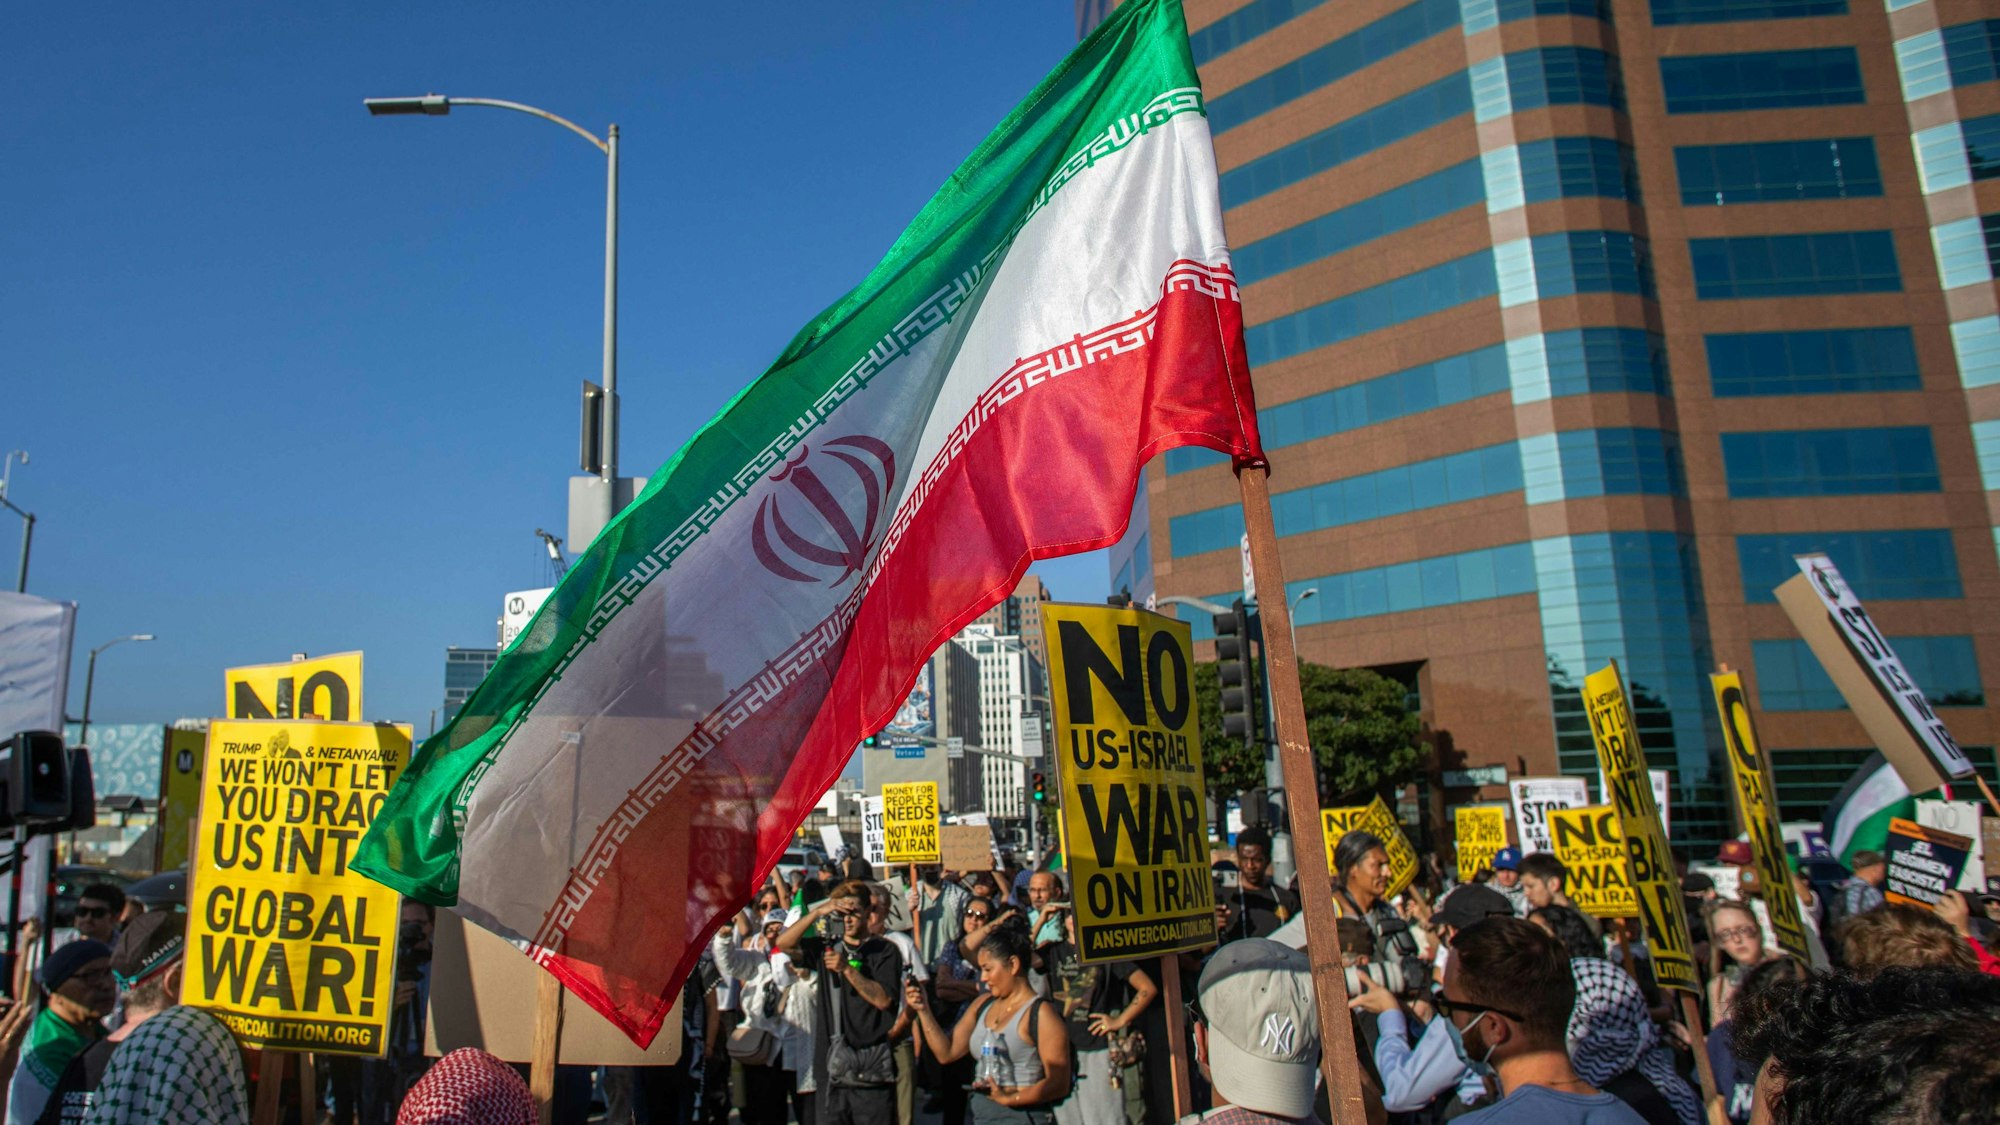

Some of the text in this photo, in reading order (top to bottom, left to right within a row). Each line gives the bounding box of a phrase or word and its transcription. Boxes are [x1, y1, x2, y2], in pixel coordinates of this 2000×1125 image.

[1057, 620, 1190, 731] NO
[223, 742, 399, 762] TRUMP & NETANYAHU:
[1071, 728, 1191, 770] US-ISRAEL
[220, 758, 397, 792] WE WON'T LET
[885, 785, 933, 795] MONEY FOR
[218, 785, 279, 823] YOU
[886, 794, 934, 807] PEOPLE'S
[886, 805, 935, 821] NEEDS
[865, 812, 884, 831] STO
[887, 824, 935, 838] NOT WAR
[1077, 783, 1204, 869] WAR
[213, 822, 360, 876] US INT
[906, 838, 936, 852] IRAN
[1561, 847, 1626, 862] US-ISRA
[1565, 863, 1630, 889] WA
[1087, 868, 1211, 919] ON IRAN!
[1603, 890, 1635, 903] IRA
[206, 885, 381, 946] GLOBAL
[1091, 914, 1213, 951] ANSWERCOALITION.ORG
[201, 935, 381, 1017] WAR!
[1260, 1013, 1294, 1056] NY
